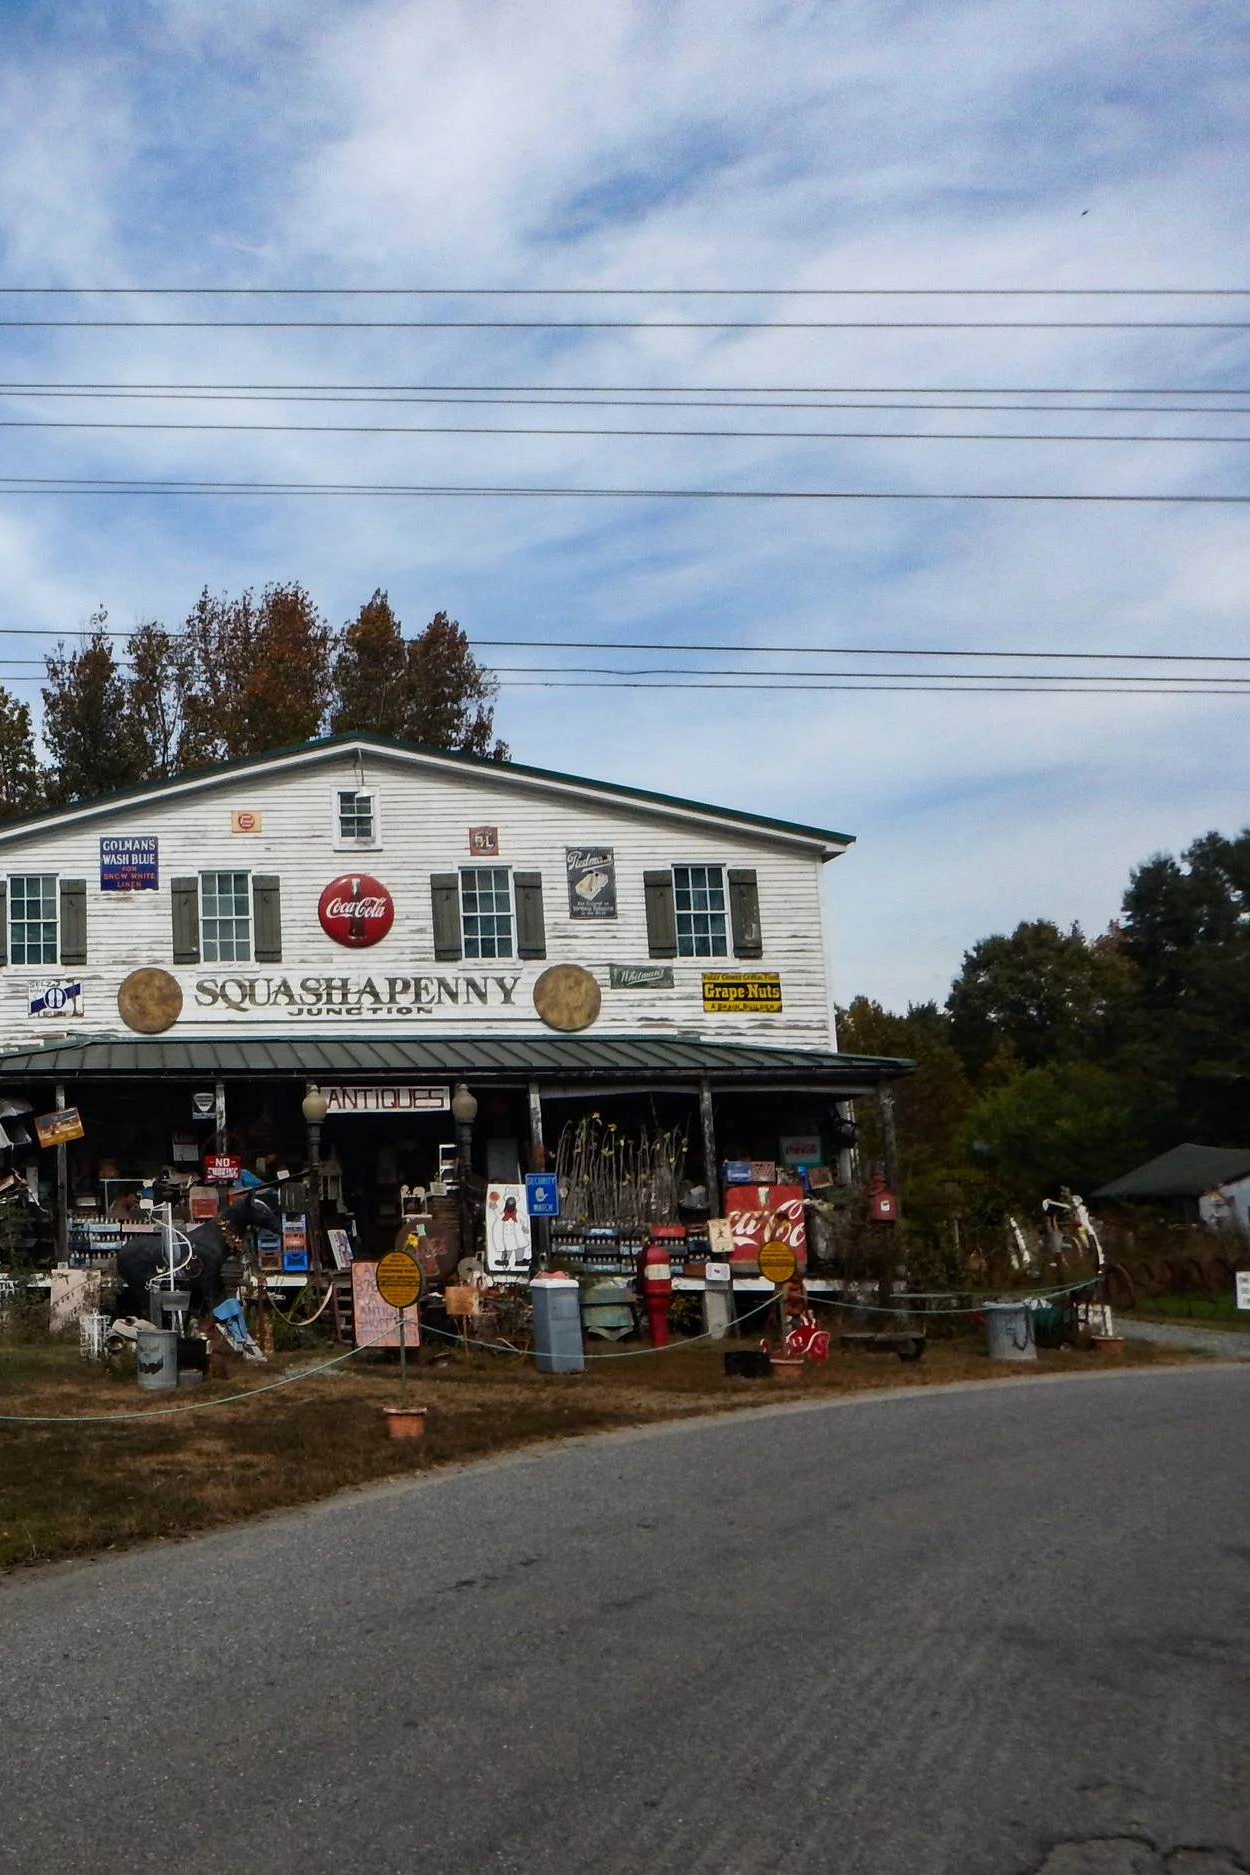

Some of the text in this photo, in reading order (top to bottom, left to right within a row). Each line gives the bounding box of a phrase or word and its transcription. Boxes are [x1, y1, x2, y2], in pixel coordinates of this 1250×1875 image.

[102, 853, 155, 865] WASH BLUE
[326, 897, 388, 919] Coca-Cola
[195, 976, 522, 1013] SQUASHAPENNY
[287, 1007, 434, 1016] JUNCTION
[328, 1088, 444, 1109] ANTIQUES
[215, 1157, 230, 1167] NO
[526, 1177, 556, 1185] SECURITY
